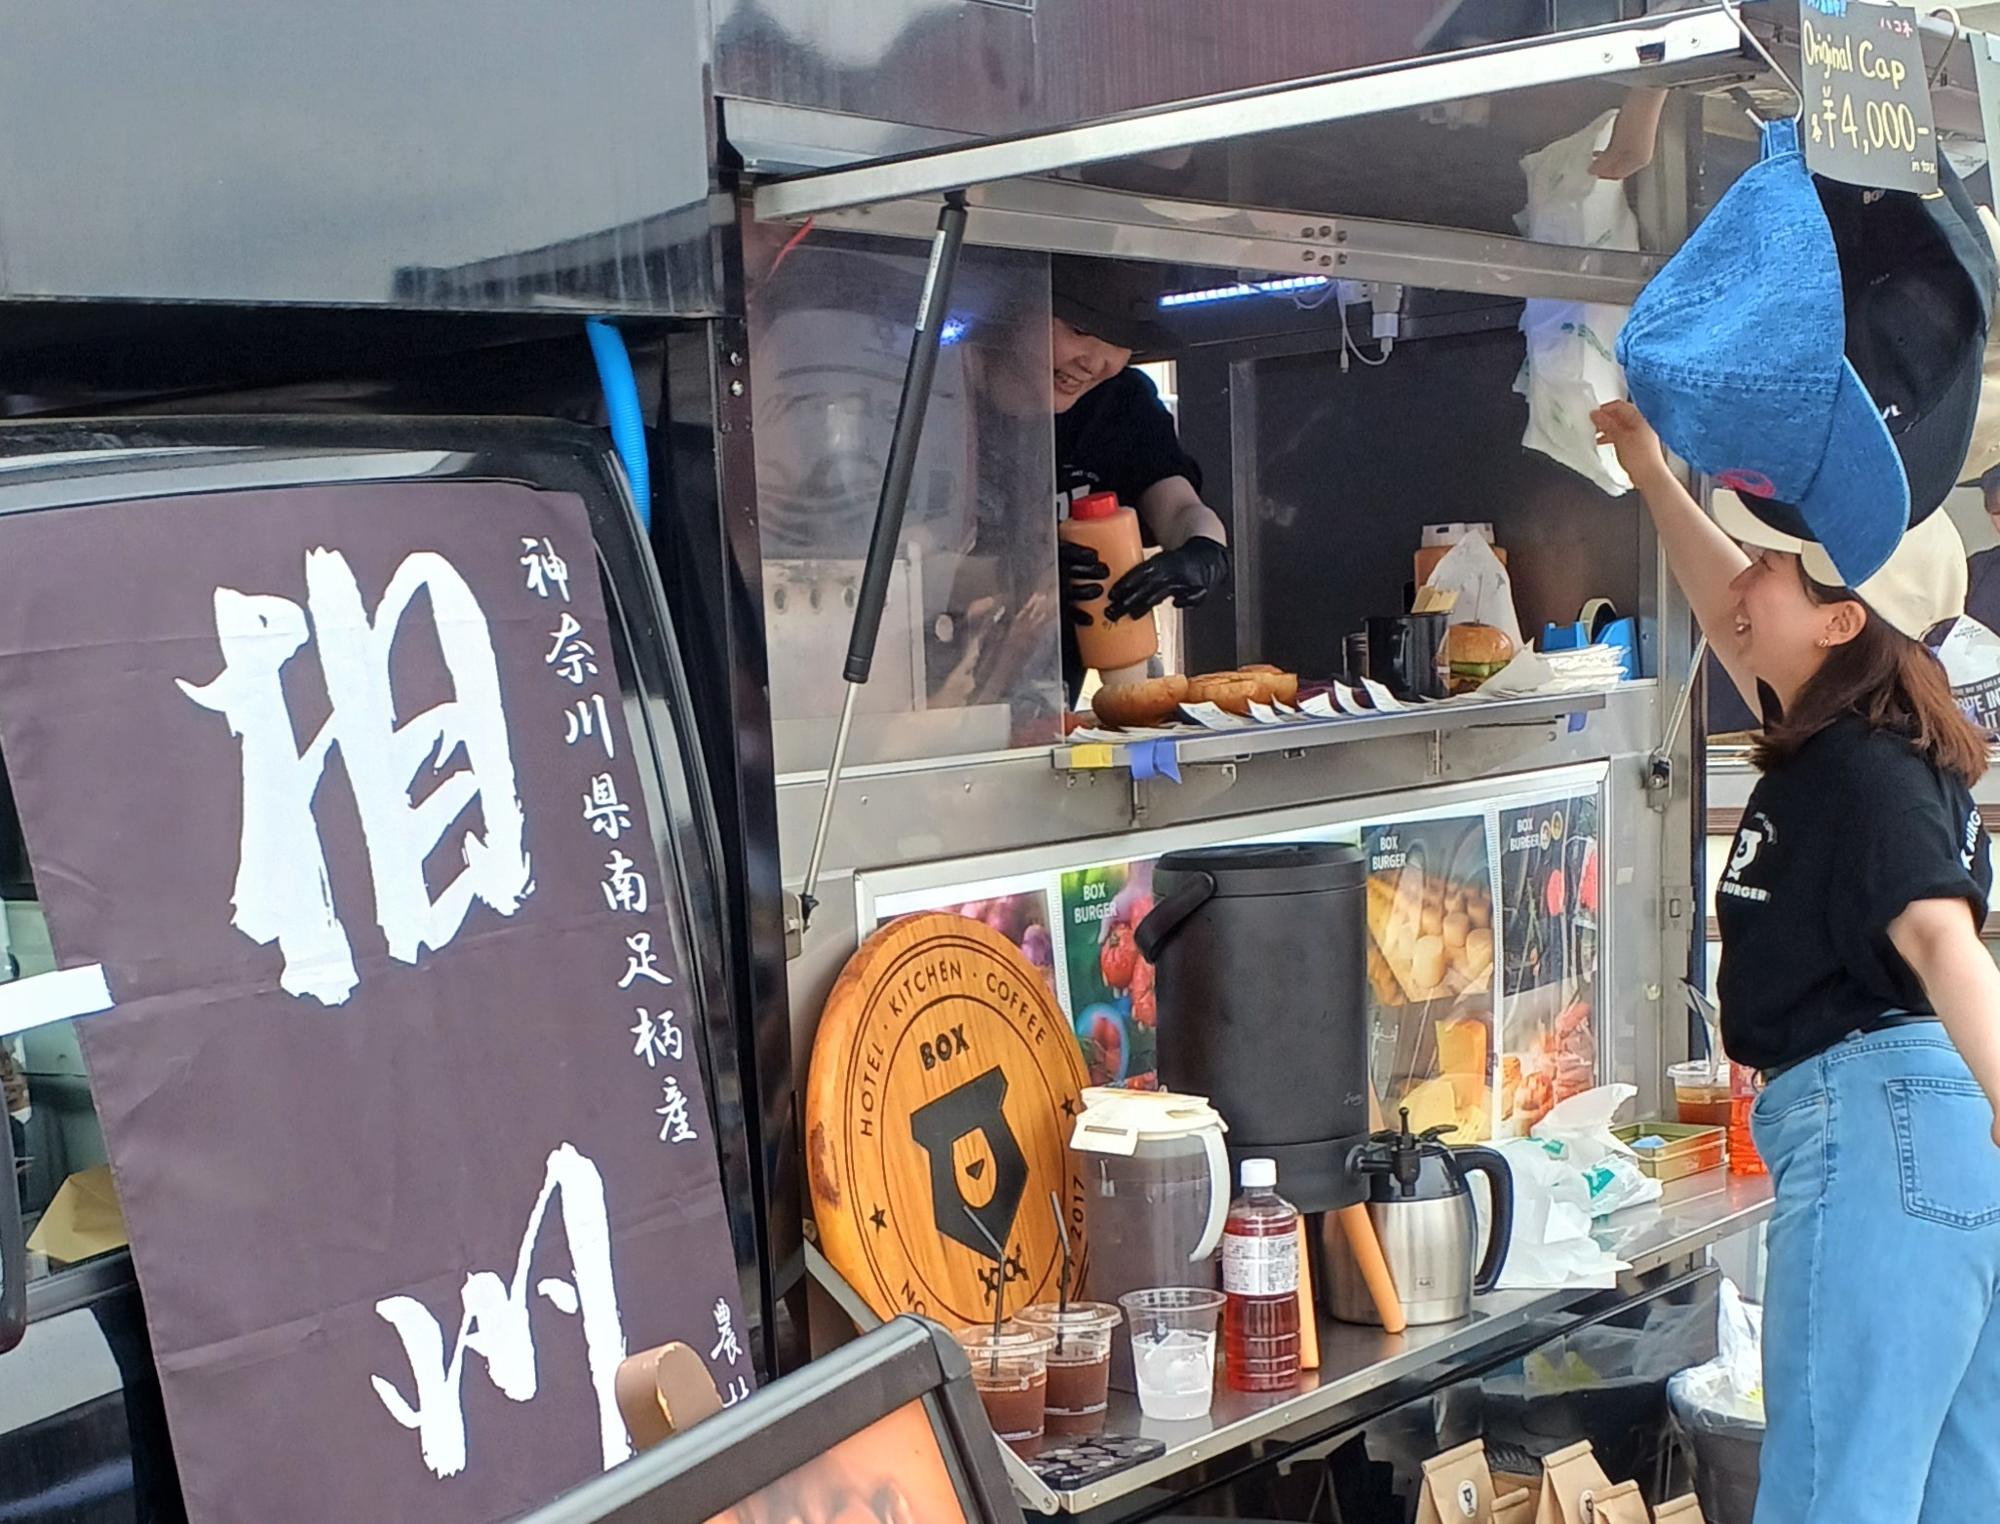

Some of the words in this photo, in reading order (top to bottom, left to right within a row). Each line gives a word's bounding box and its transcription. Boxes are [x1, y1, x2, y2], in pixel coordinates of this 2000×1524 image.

[1803, 19, 1853, 79] Original
[1859, 40, 1905, 90] Cap
[520, 537, 698, 1143] 神奈川県南足柄産
[1517, 817, 1533, 833] BOX
[1966, 806, 1981, 853] BURG
[1380, 835, 1398, 851] BOX
[1372, 853, 1406, 870] BURGER
[1083, 882, 1106, 901] BOX
[1722, 881, 1767, 901] BURGER
[1074, 902, 1117, 924] BURGER
[861, 1041, 884, 1136] HOTEL
[889, 960, 962, 1017] KITCHEN
[986, 972, 1046, 1045] COFFEE
[919, 1023, 969, 1071] BOX
[1070, 1175, 1085, 1241] 2017
